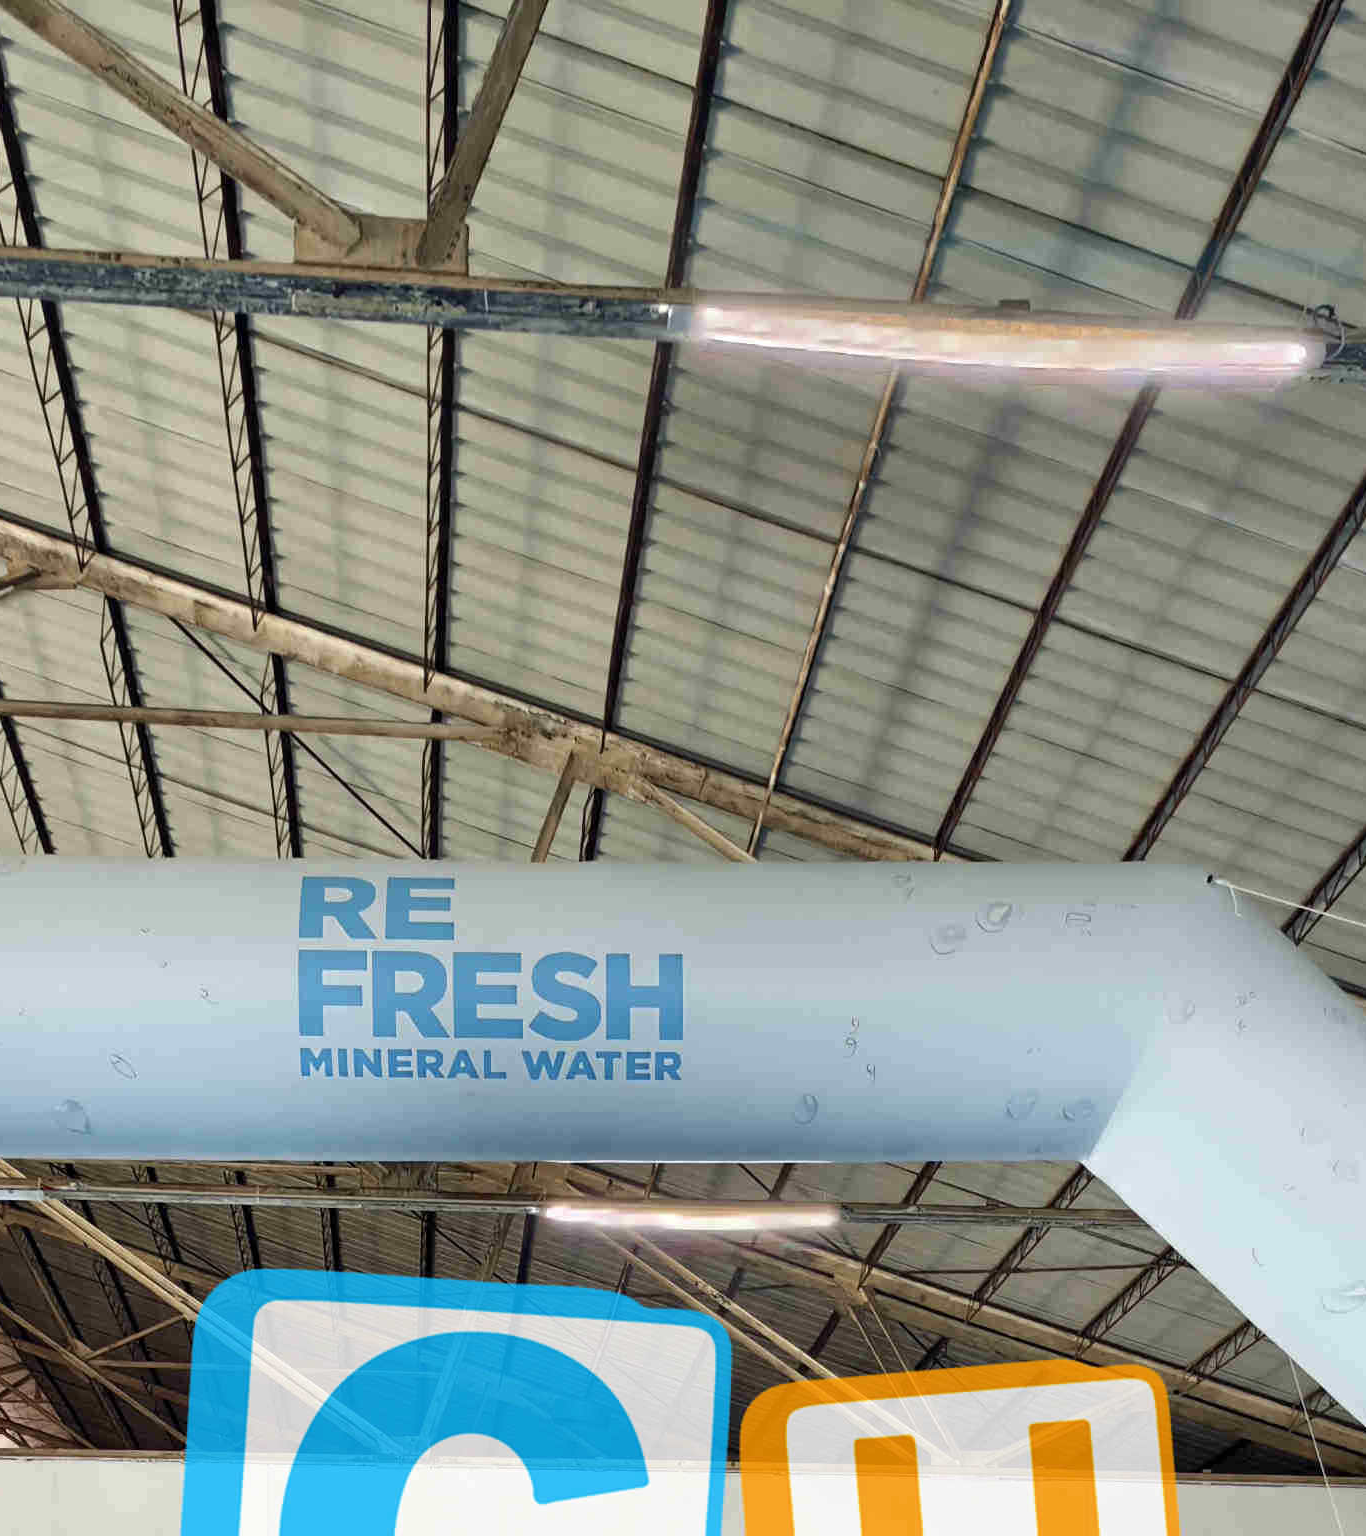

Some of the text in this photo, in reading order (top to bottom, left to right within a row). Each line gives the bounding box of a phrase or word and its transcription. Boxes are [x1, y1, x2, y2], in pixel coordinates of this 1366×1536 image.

[298, 875, 456, 941] RE
[297, 949, 684, 1041] FRESH
[299, 1046, 683, 1081] MINERAL WATER
